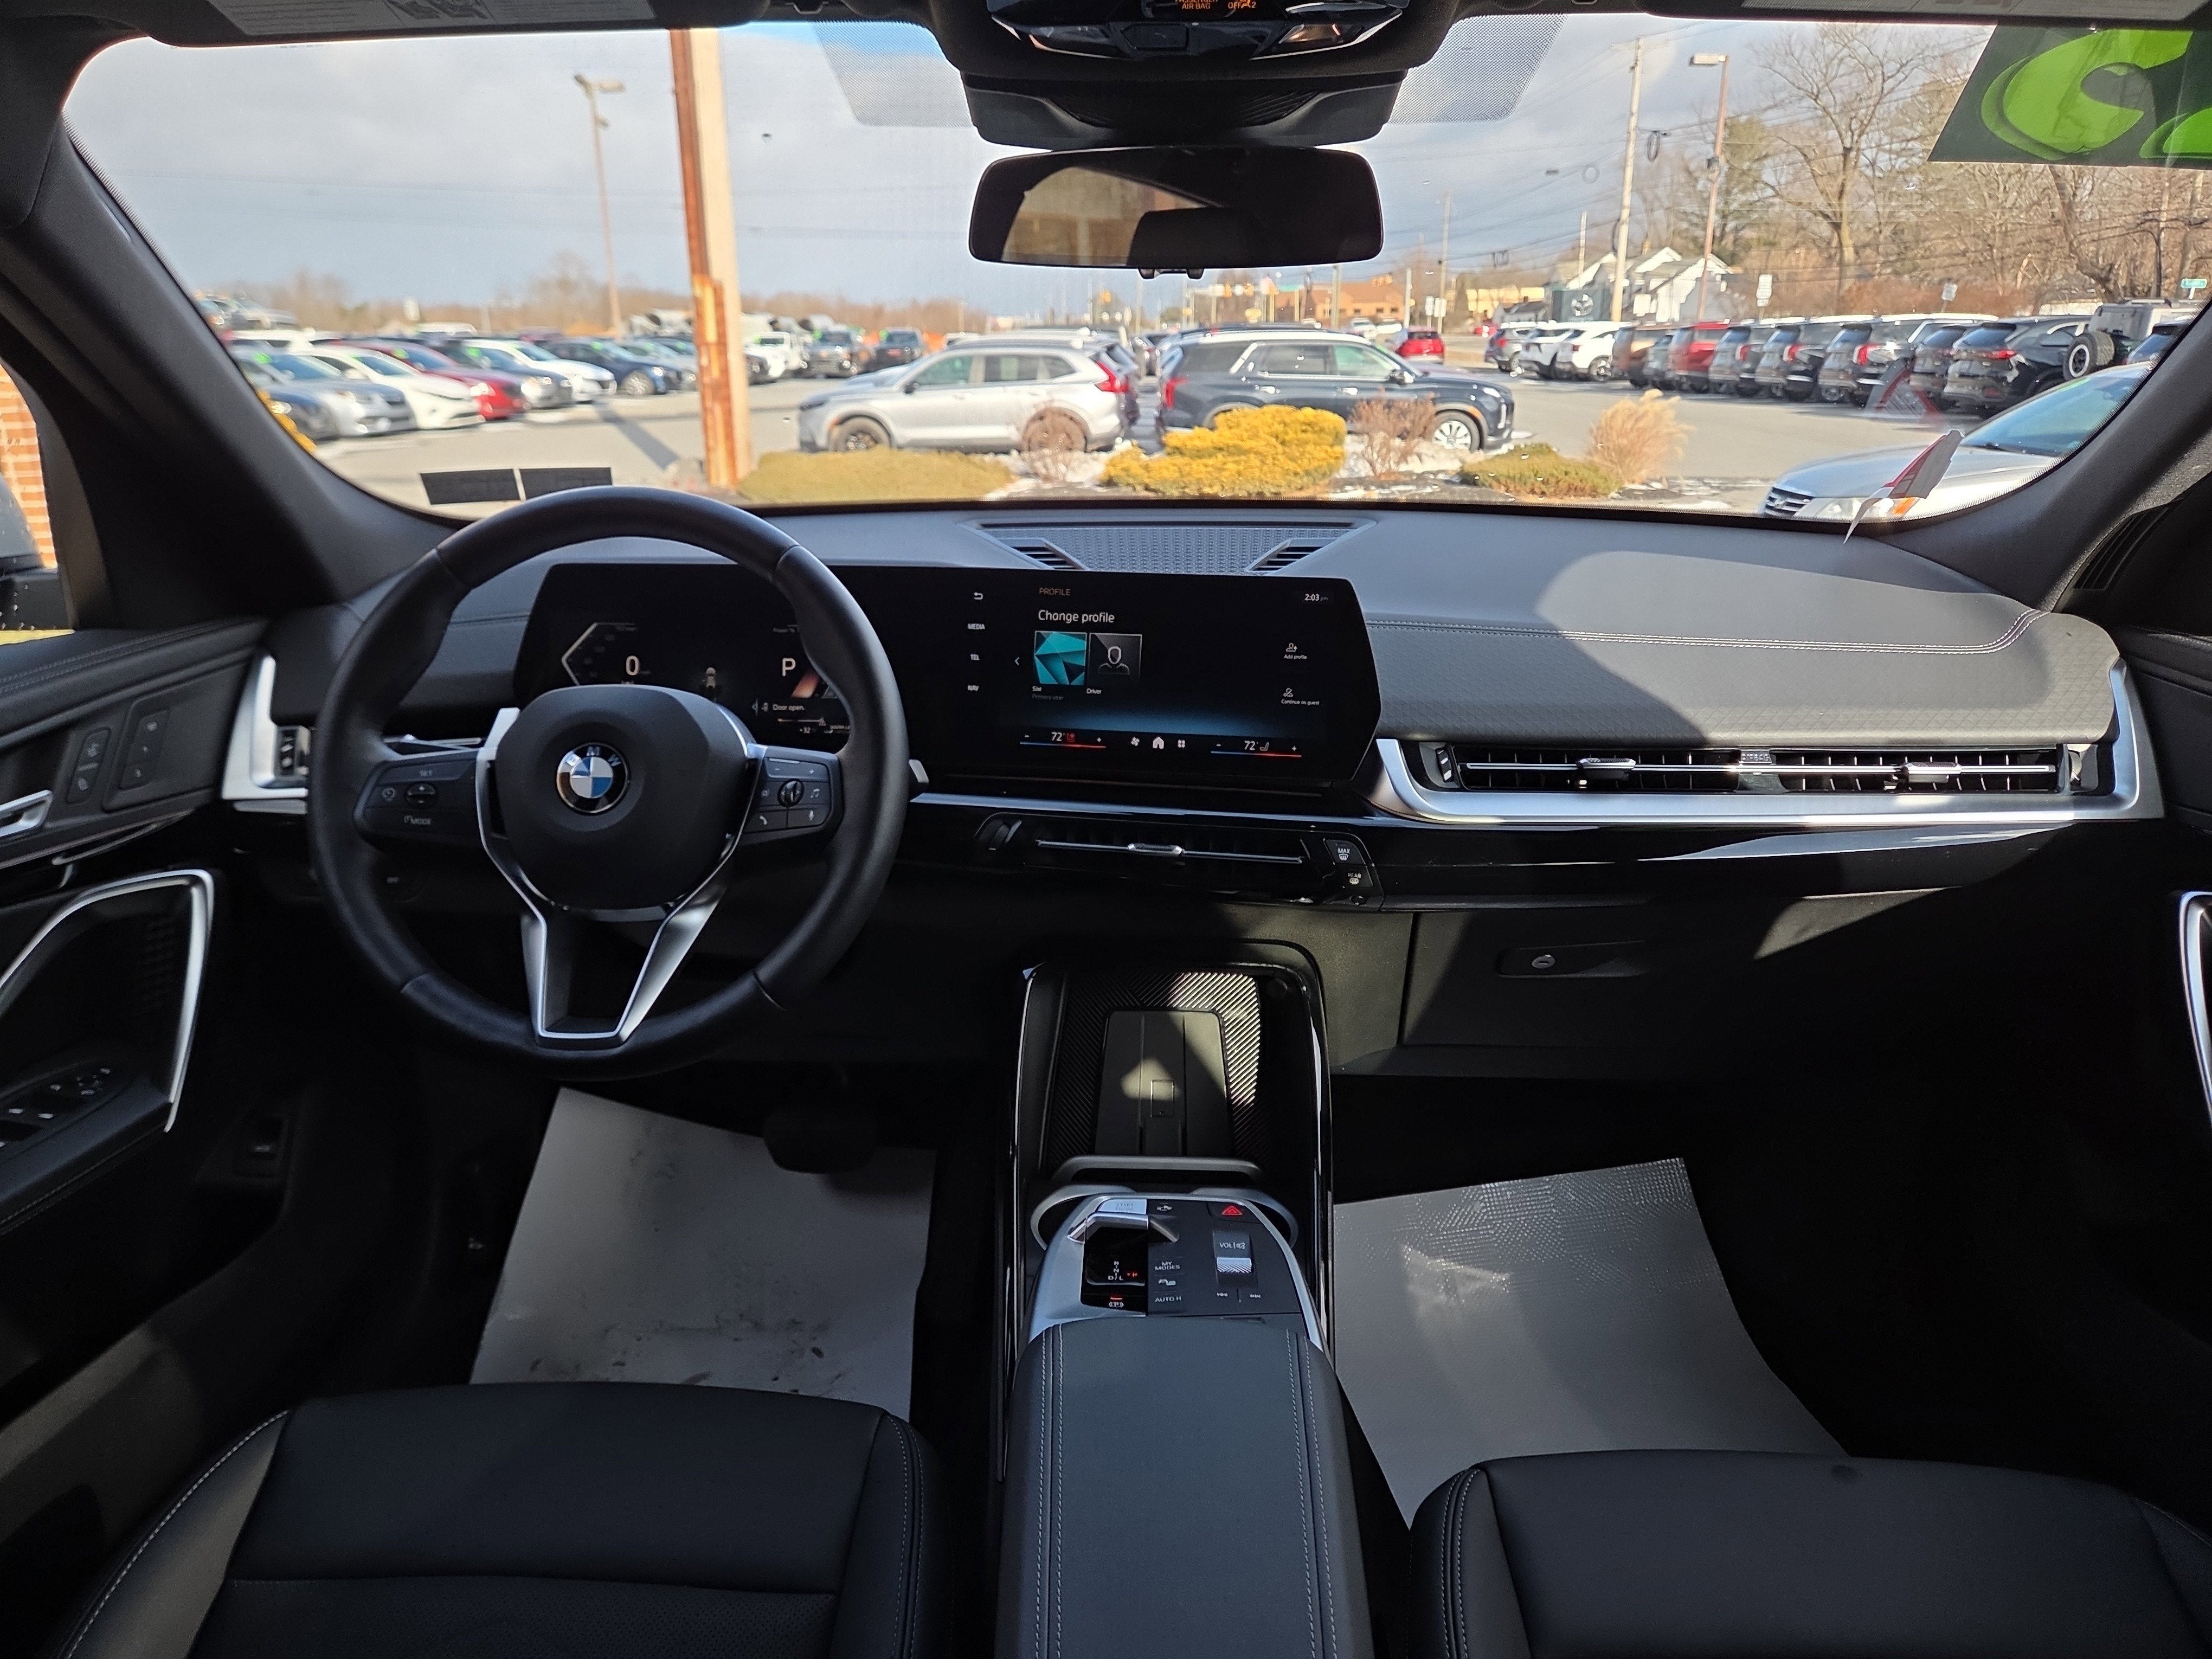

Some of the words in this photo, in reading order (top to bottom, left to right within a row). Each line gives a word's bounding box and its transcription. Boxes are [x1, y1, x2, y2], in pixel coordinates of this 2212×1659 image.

[1038, 587, 1072, 596] PROFILE
[1304, 593, 1320, 601] 2:03
[1038, 609, 1079, 624] Change
[1081, 612, 1115, 624] profile
[626, 655, 640, 676] 0
[782, 657, 796, 677] P
